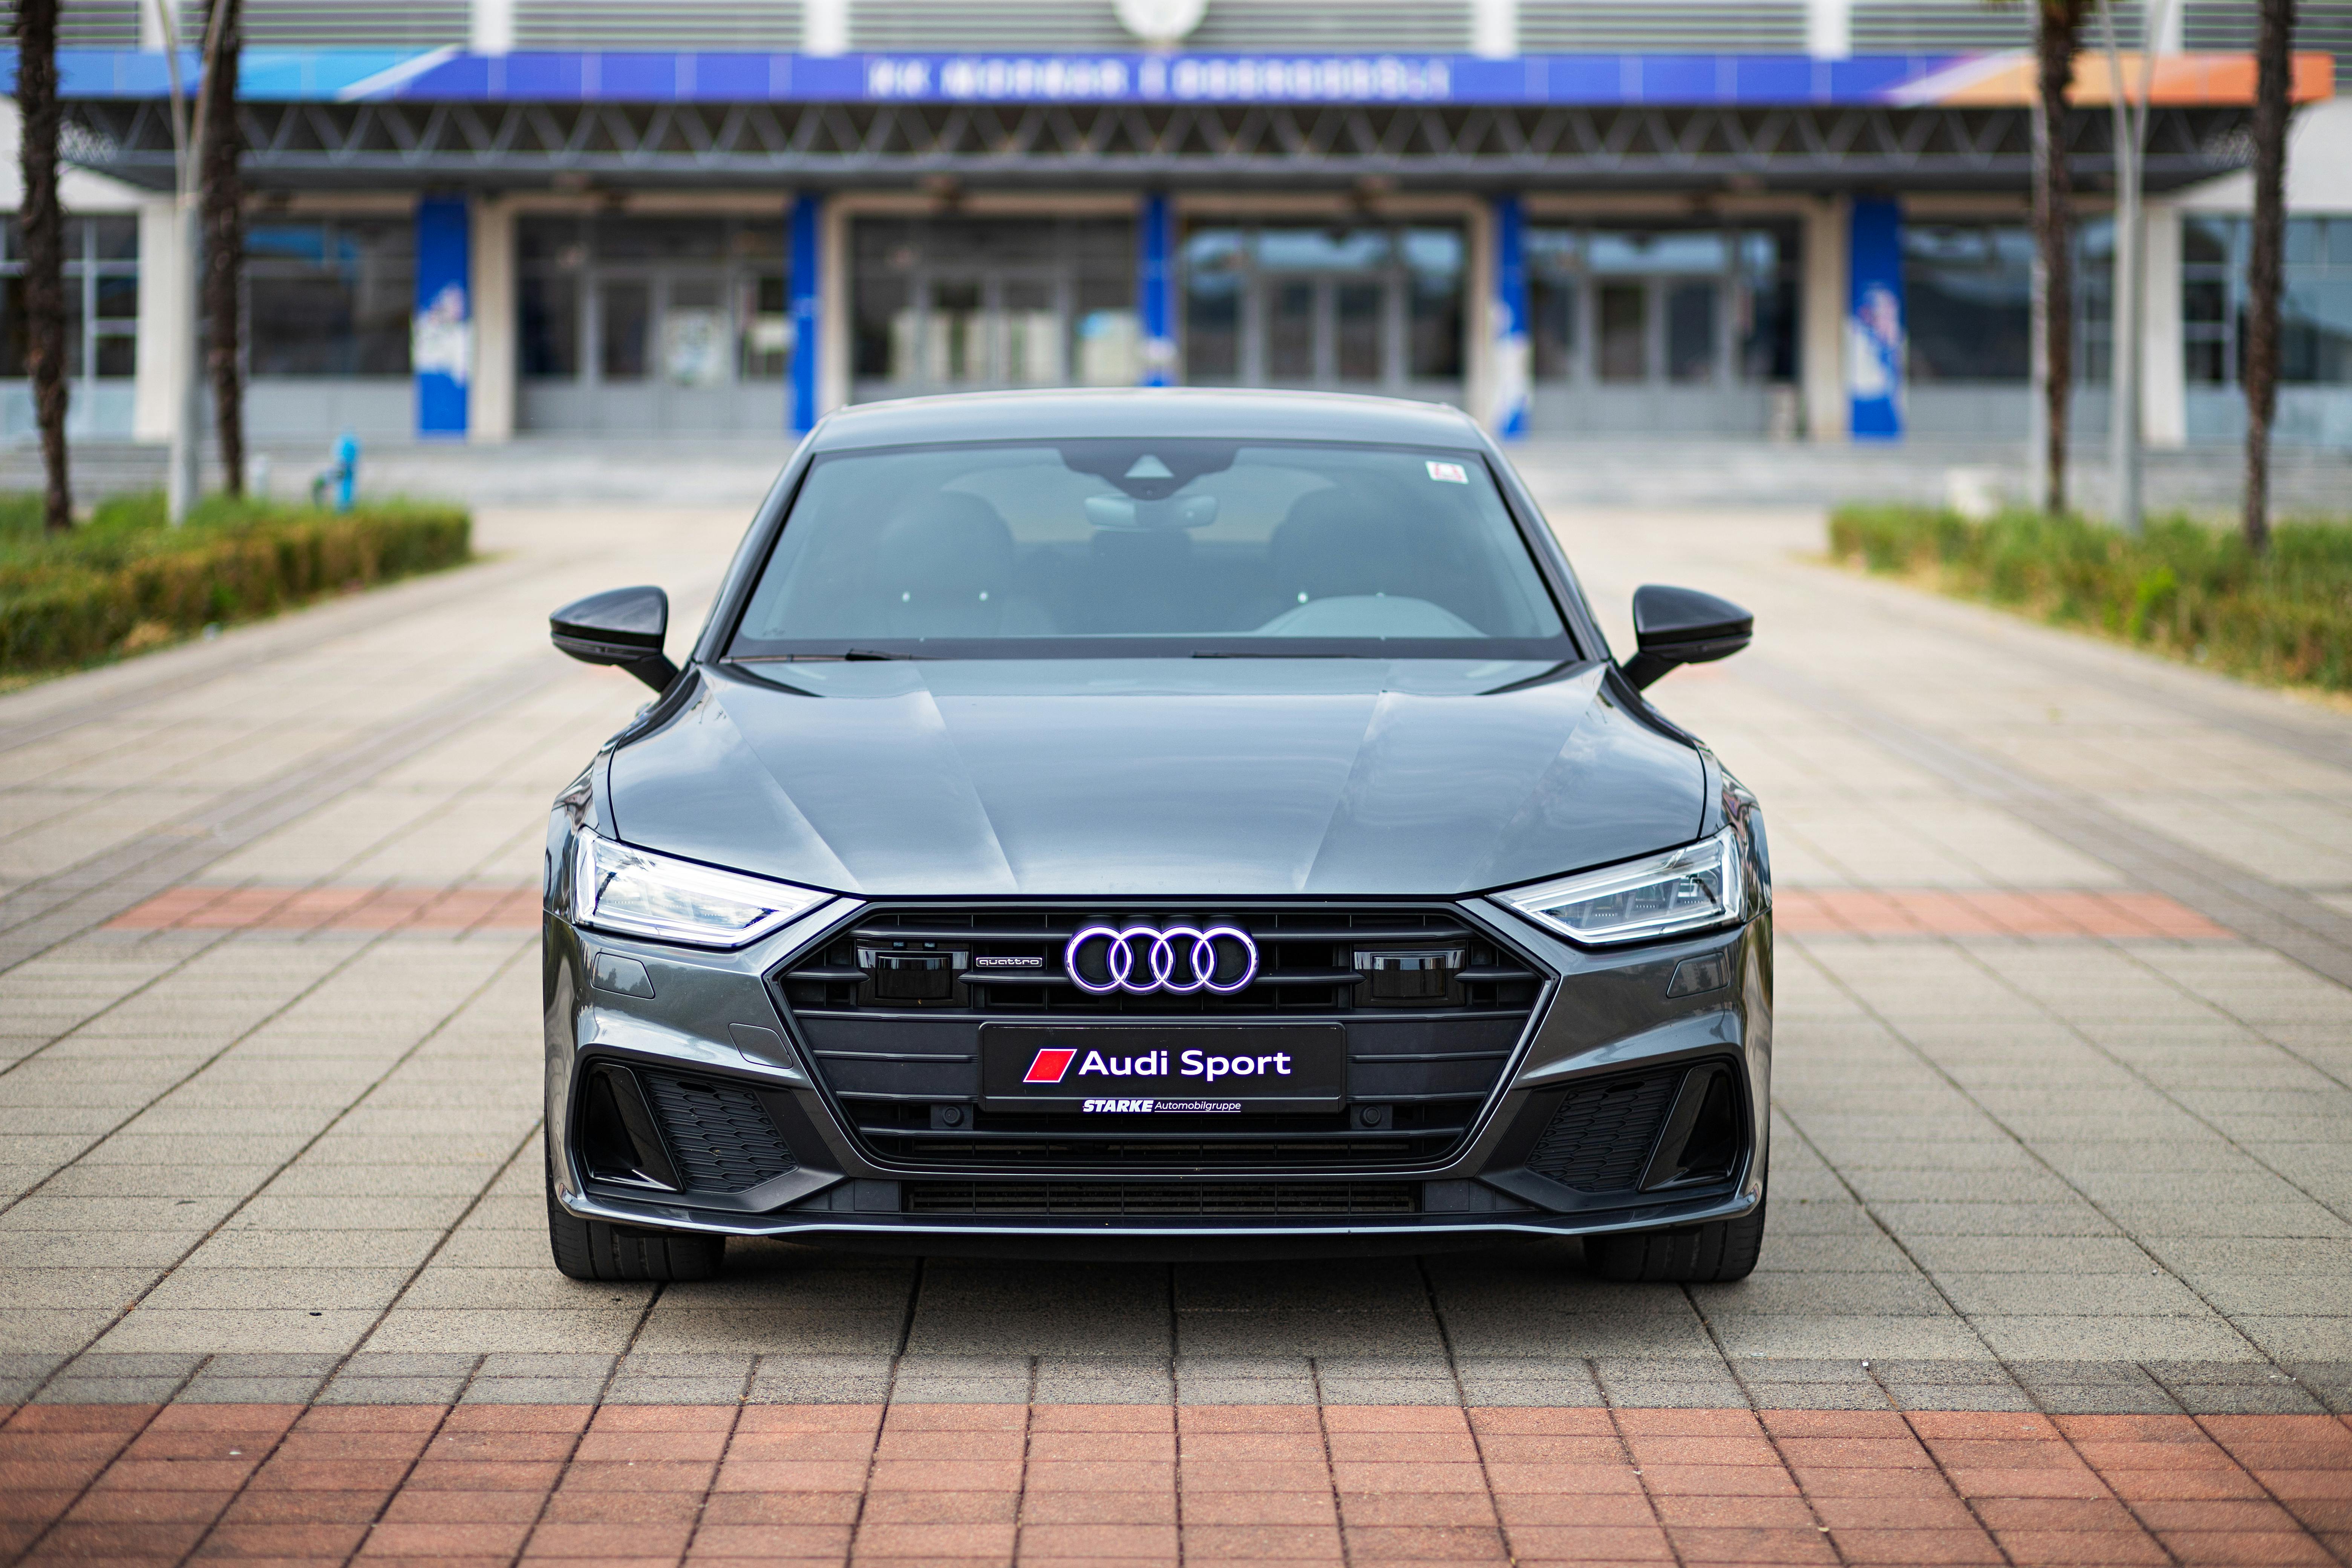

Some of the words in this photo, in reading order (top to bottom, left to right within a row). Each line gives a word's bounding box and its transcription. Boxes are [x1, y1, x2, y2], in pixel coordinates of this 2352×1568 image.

[1078, 1050, 1167, 1075] Audi
[1181, 1050, 1291, 1081] Sport
[1083, 1099, 1154, 1112] STARKE
[1155, 1101, 1241, 1111] Automobilgruppe
